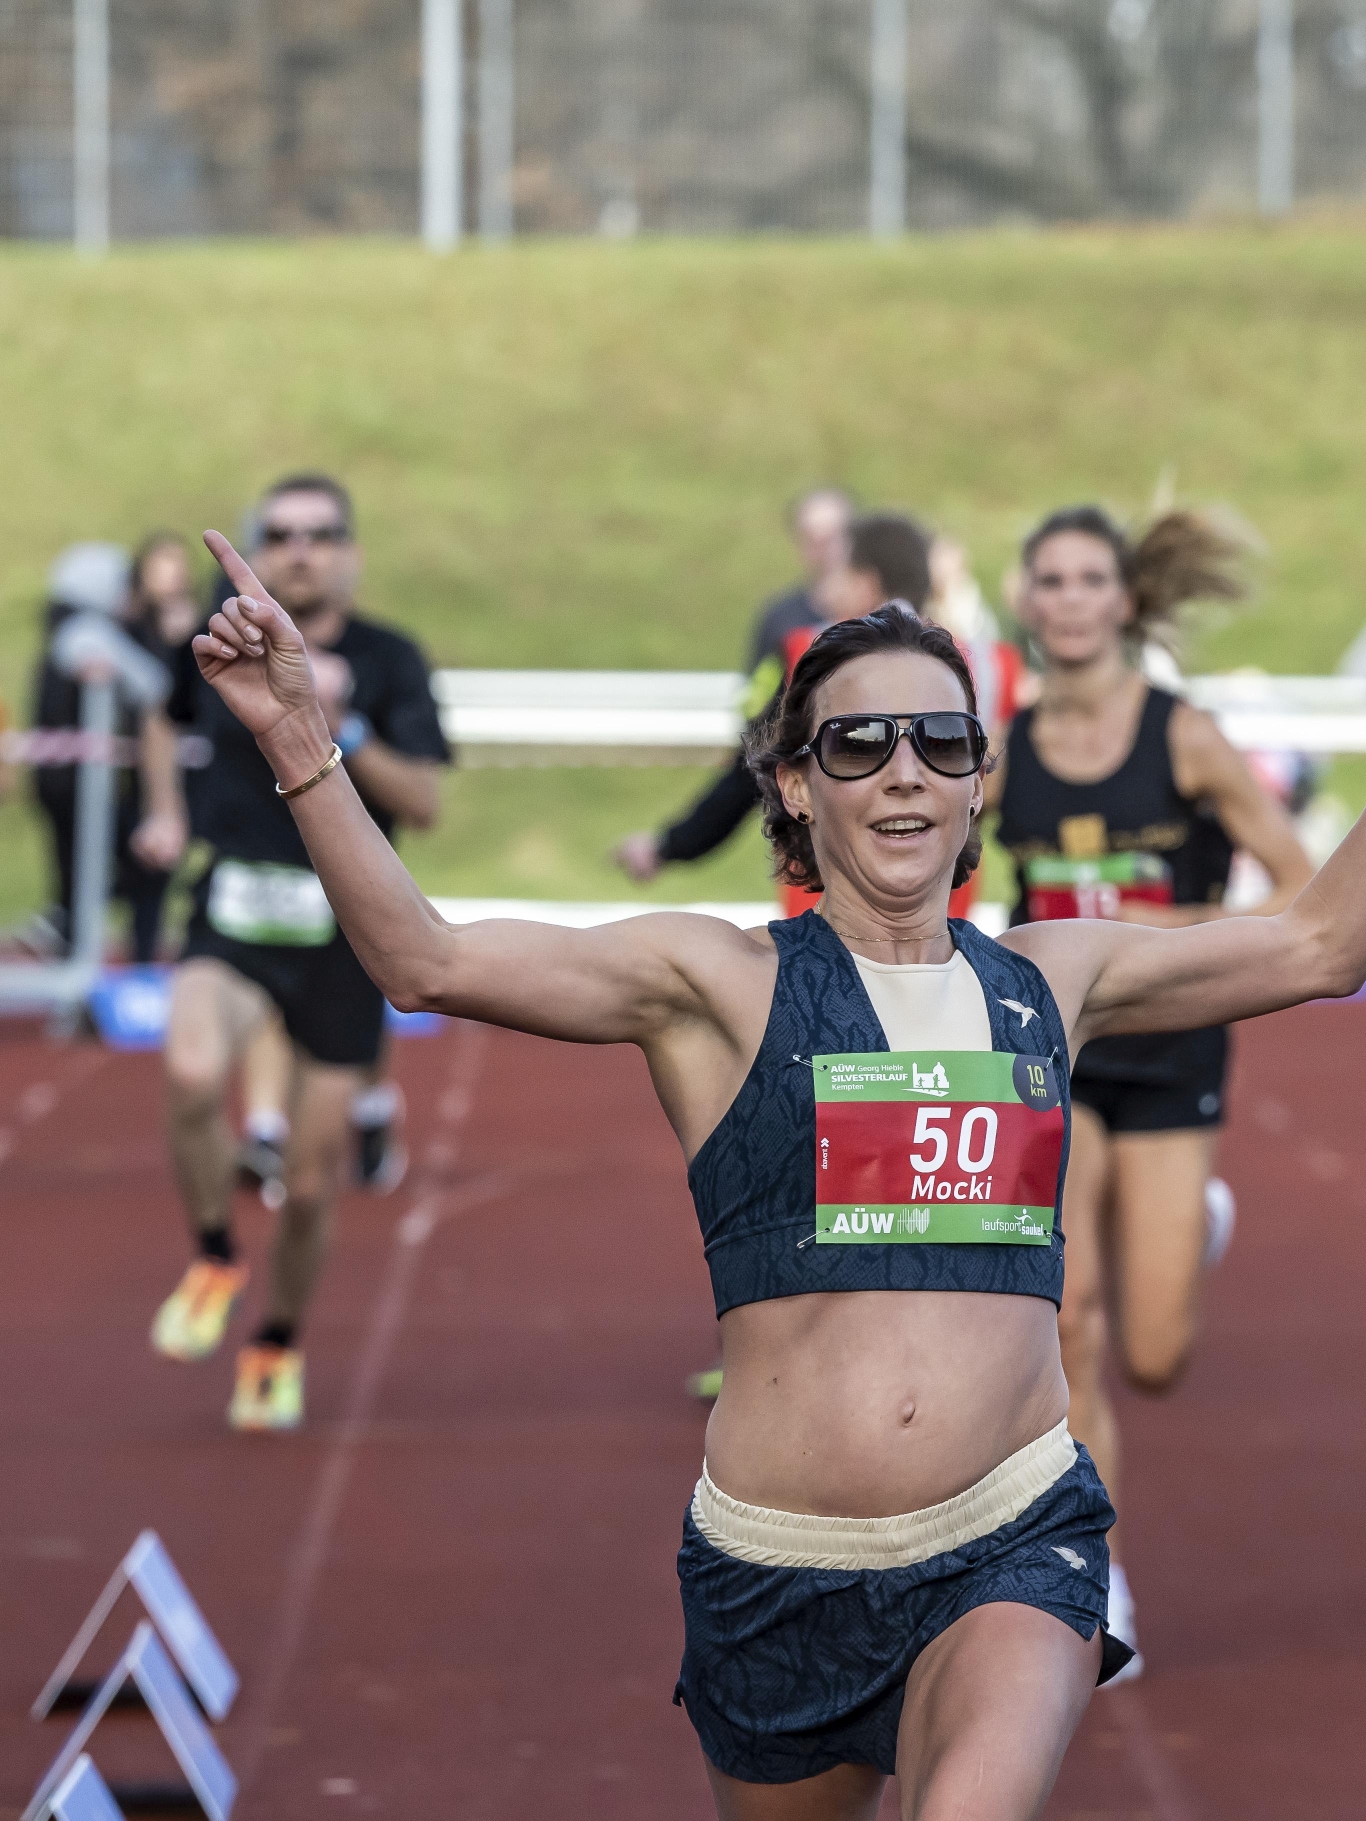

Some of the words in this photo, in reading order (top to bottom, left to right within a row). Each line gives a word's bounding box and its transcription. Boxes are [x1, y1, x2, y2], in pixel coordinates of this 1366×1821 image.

[830, 1063, 856, 1073] AÜW
[857, 1064, 880, 1073] Georg
[831, 1073, 908, 1082] SILVESTERLAUF
[1026, 1064, 1045, 1086] 10
[1030, 1085, 1048, 1098] km
[909, 1106, 999, 1174] 50
[911, 1175, 993, 1200] Mocki
[832, 1207, 895, 1235] AÜW
